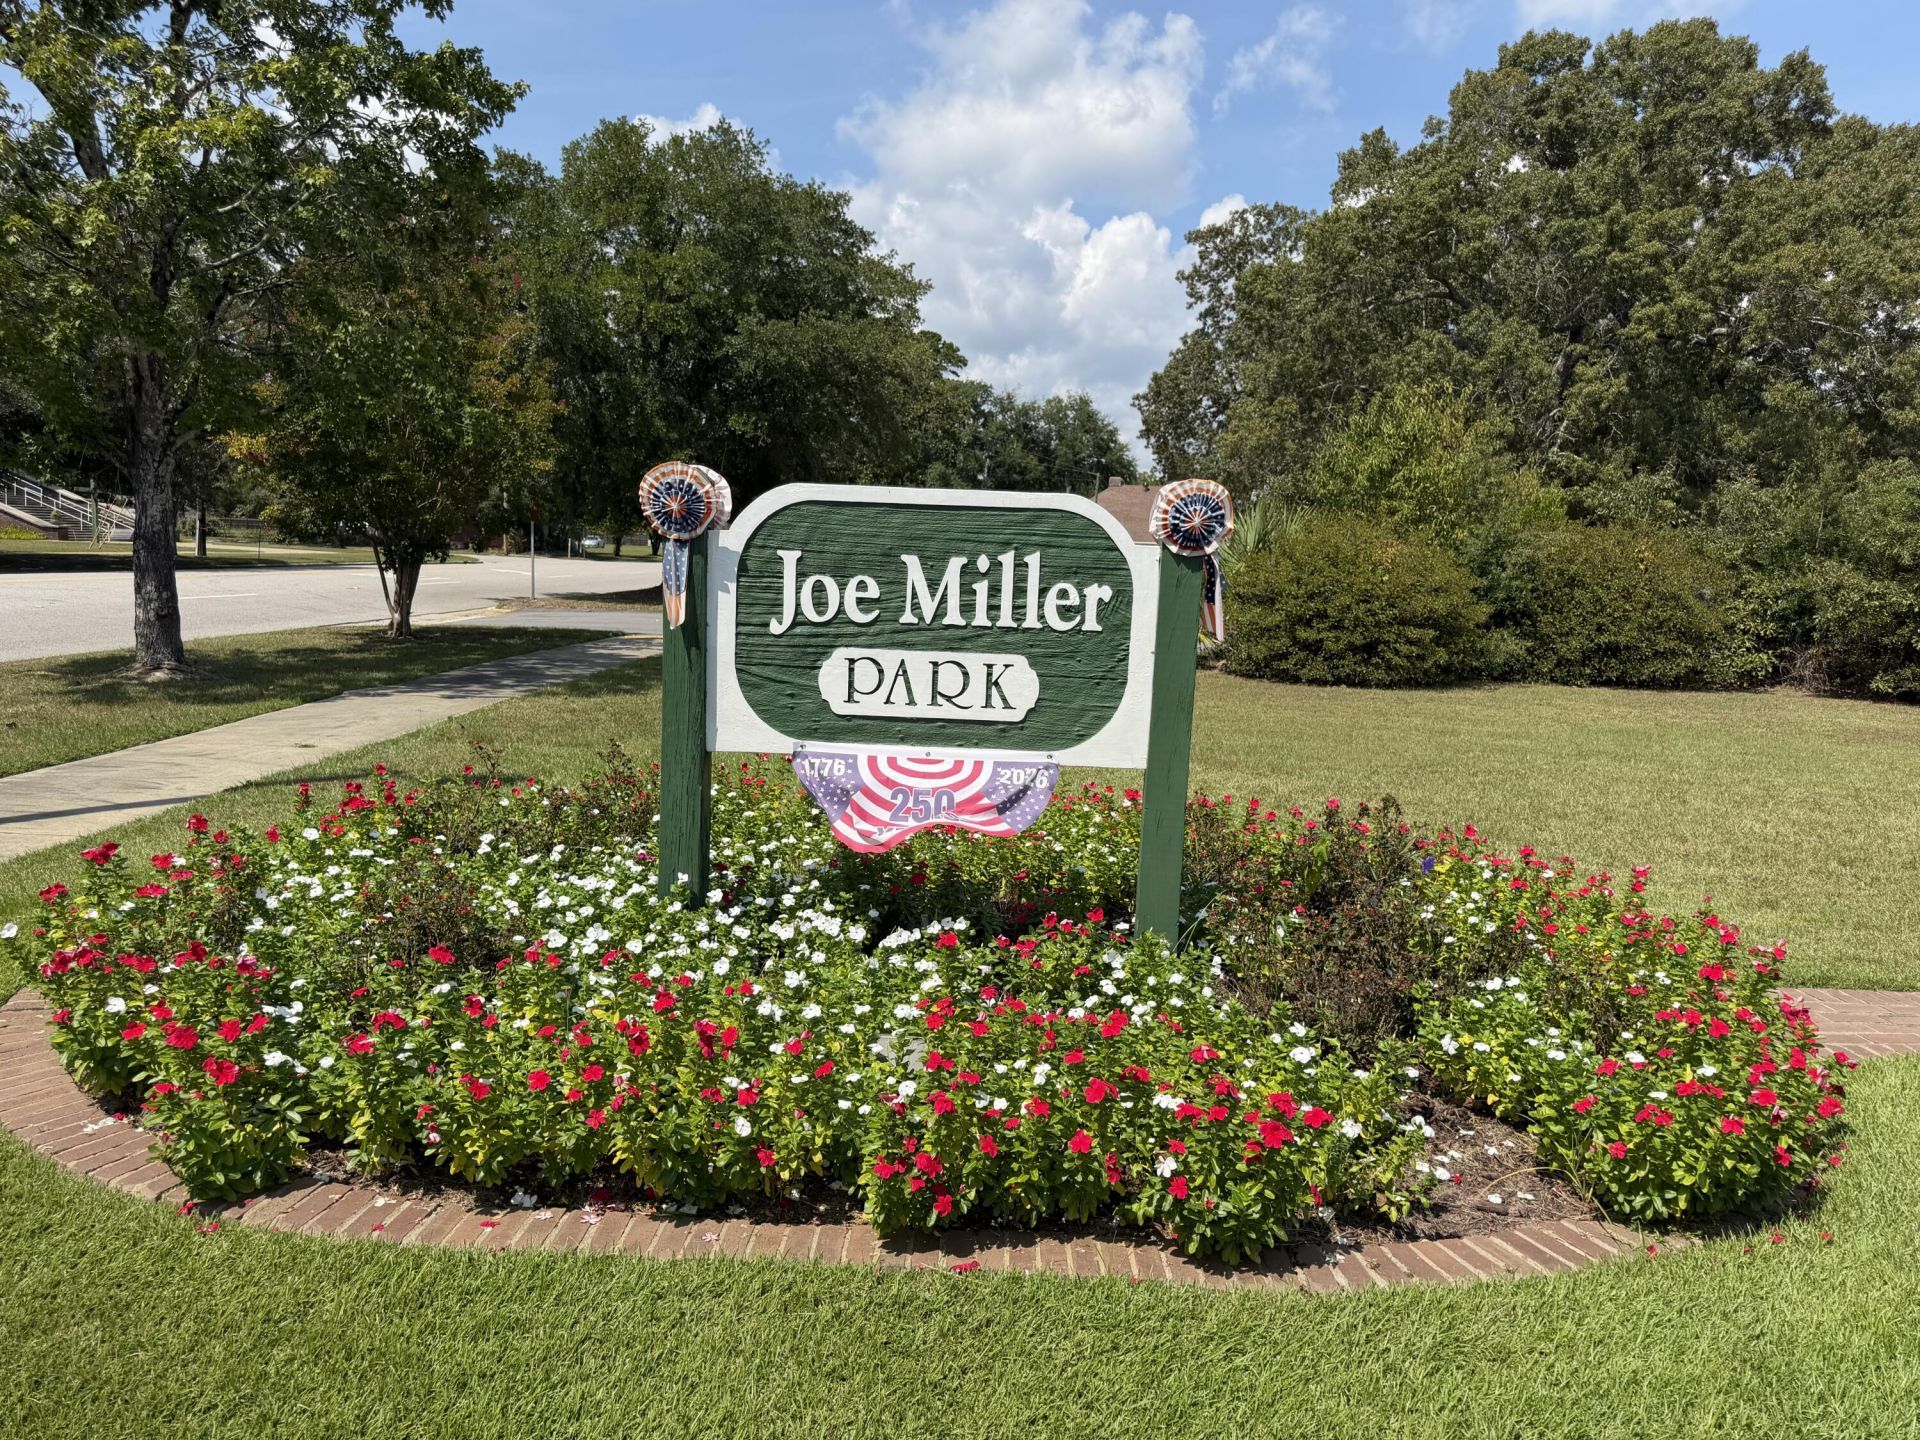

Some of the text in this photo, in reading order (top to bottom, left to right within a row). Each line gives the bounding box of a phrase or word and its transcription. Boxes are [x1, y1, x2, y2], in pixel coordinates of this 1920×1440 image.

[769, 550, 1113, 636] Joe Miller
[843, 656, 1017, 710] PARK
[802, 758, 846, 777] 1776
[1000, 768, 1050, 789] 2026
[889, 787, 956, 824] 250
